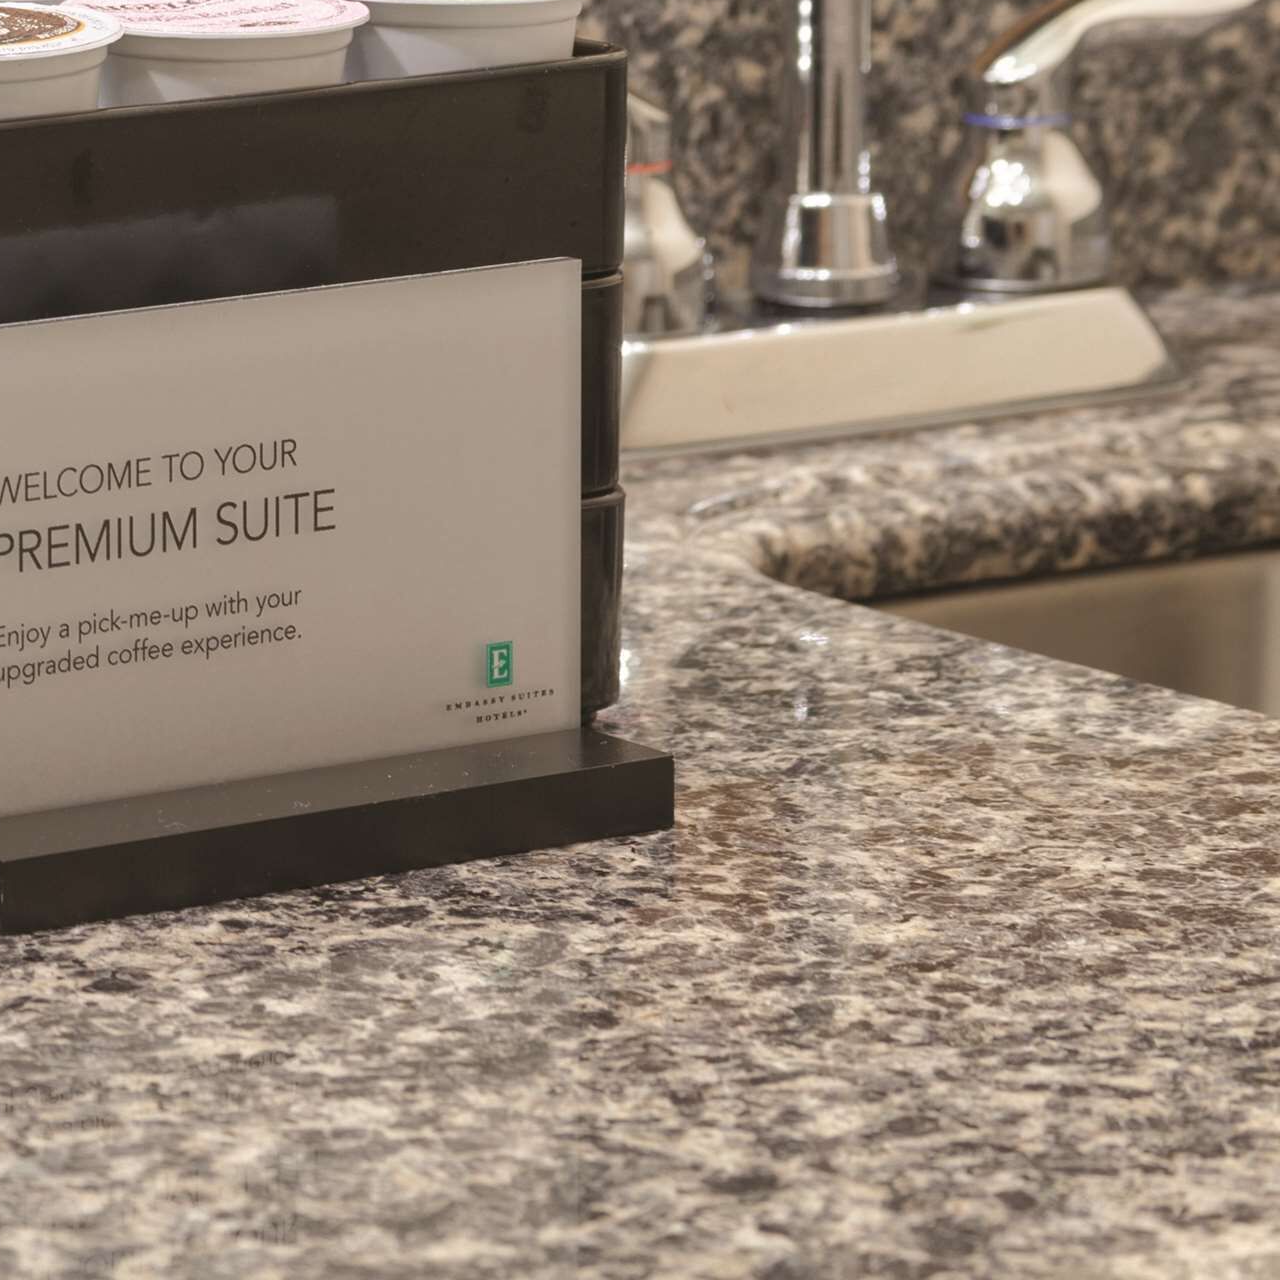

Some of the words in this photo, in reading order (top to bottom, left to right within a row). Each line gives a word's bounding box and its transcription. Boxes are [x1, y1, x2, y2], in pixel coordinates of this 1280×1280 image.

[161, 451, 204, 483] TO
[214, 438, 298, 476] YOUR
[215, 488, 336, 546] SUITE
[58, 622, 70, 639] a
[78, 608, 199, 644] pick-me-up
[205, 591, 248, 618] with
[255, 589, 302, 617] your
[107, 638, 174, 668] coffee
[181, 624, 302, 660] experience.
[491, 648, 509, 680] E
